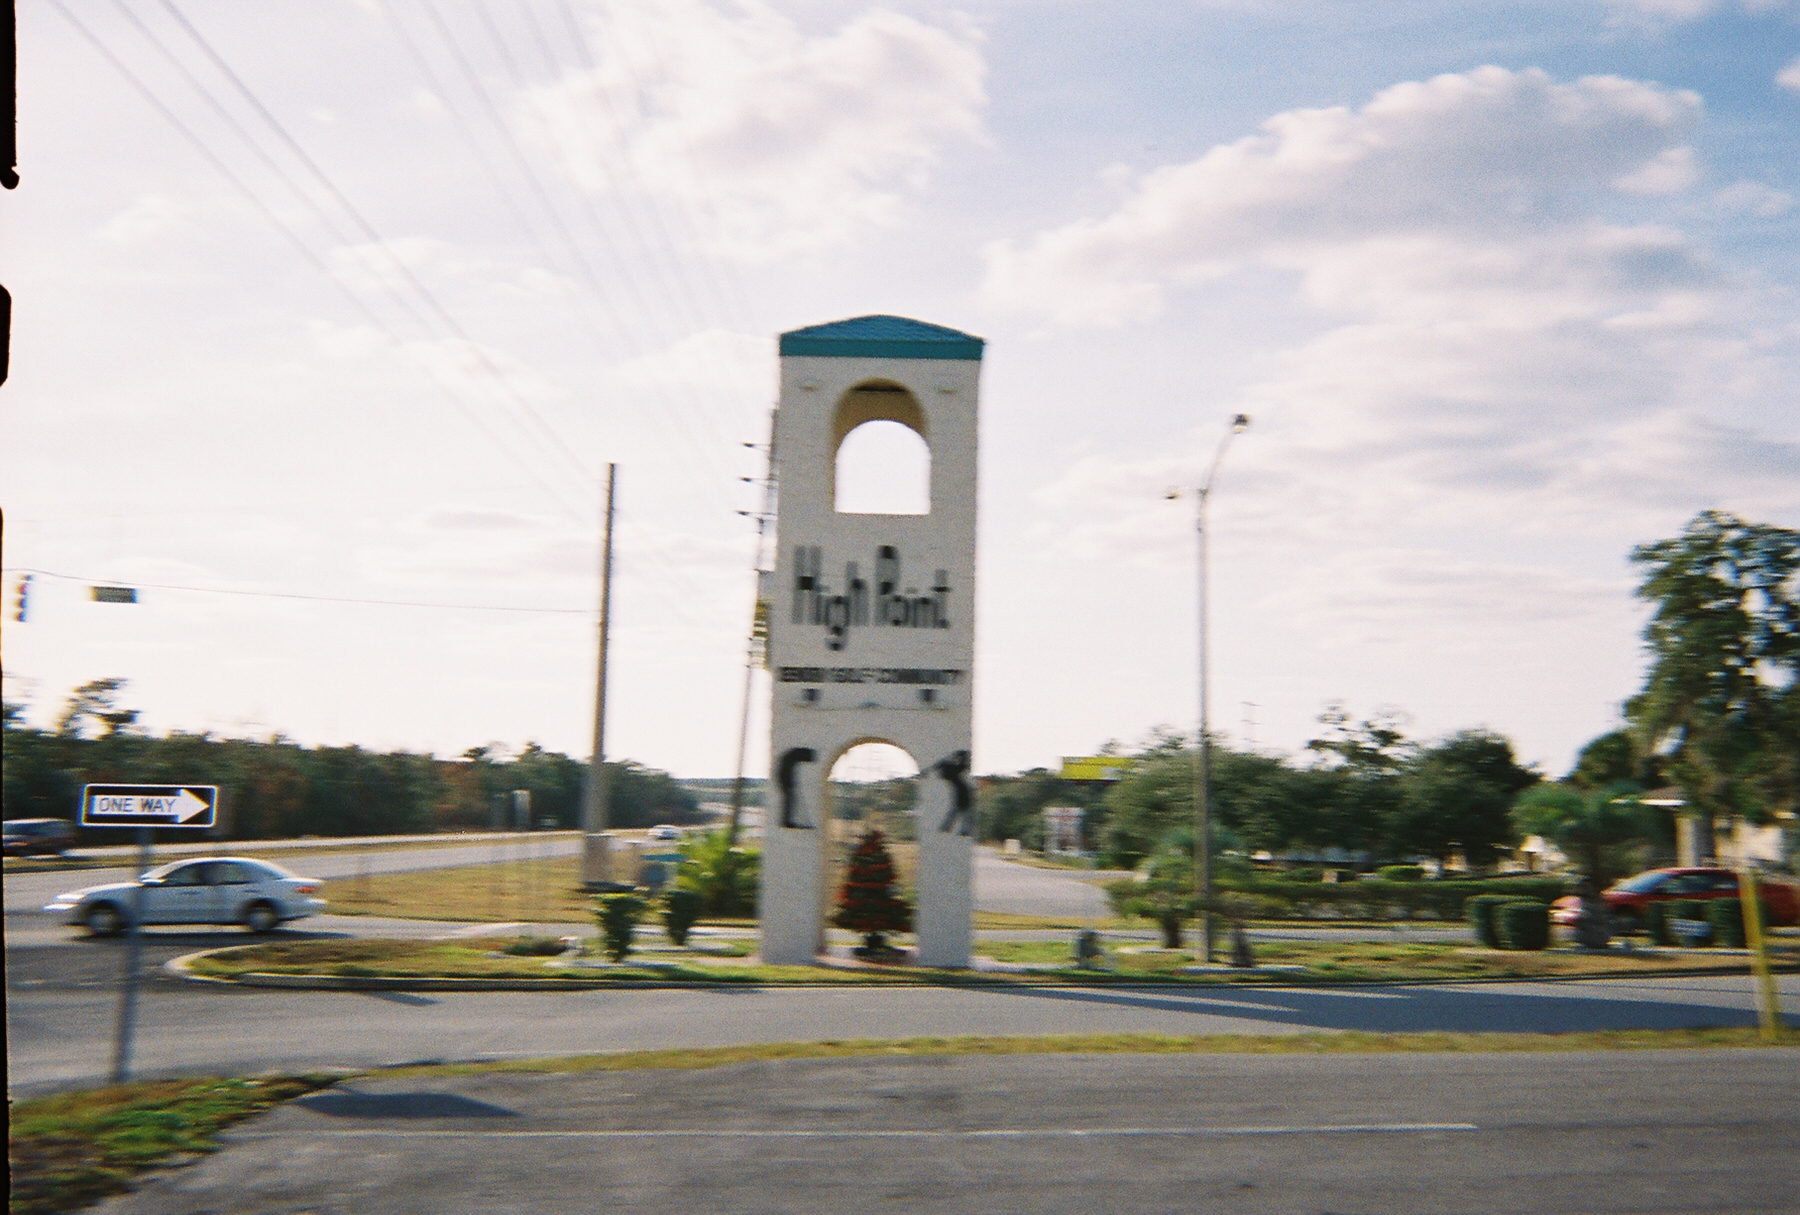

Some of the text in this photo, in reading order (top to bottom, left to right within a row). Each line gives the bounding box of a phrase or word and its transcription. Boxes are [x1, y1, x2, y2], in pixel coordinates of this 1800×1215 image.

[792, 545, 951, 650] High Point
[99, 797, 177, 813] ONE WAY
